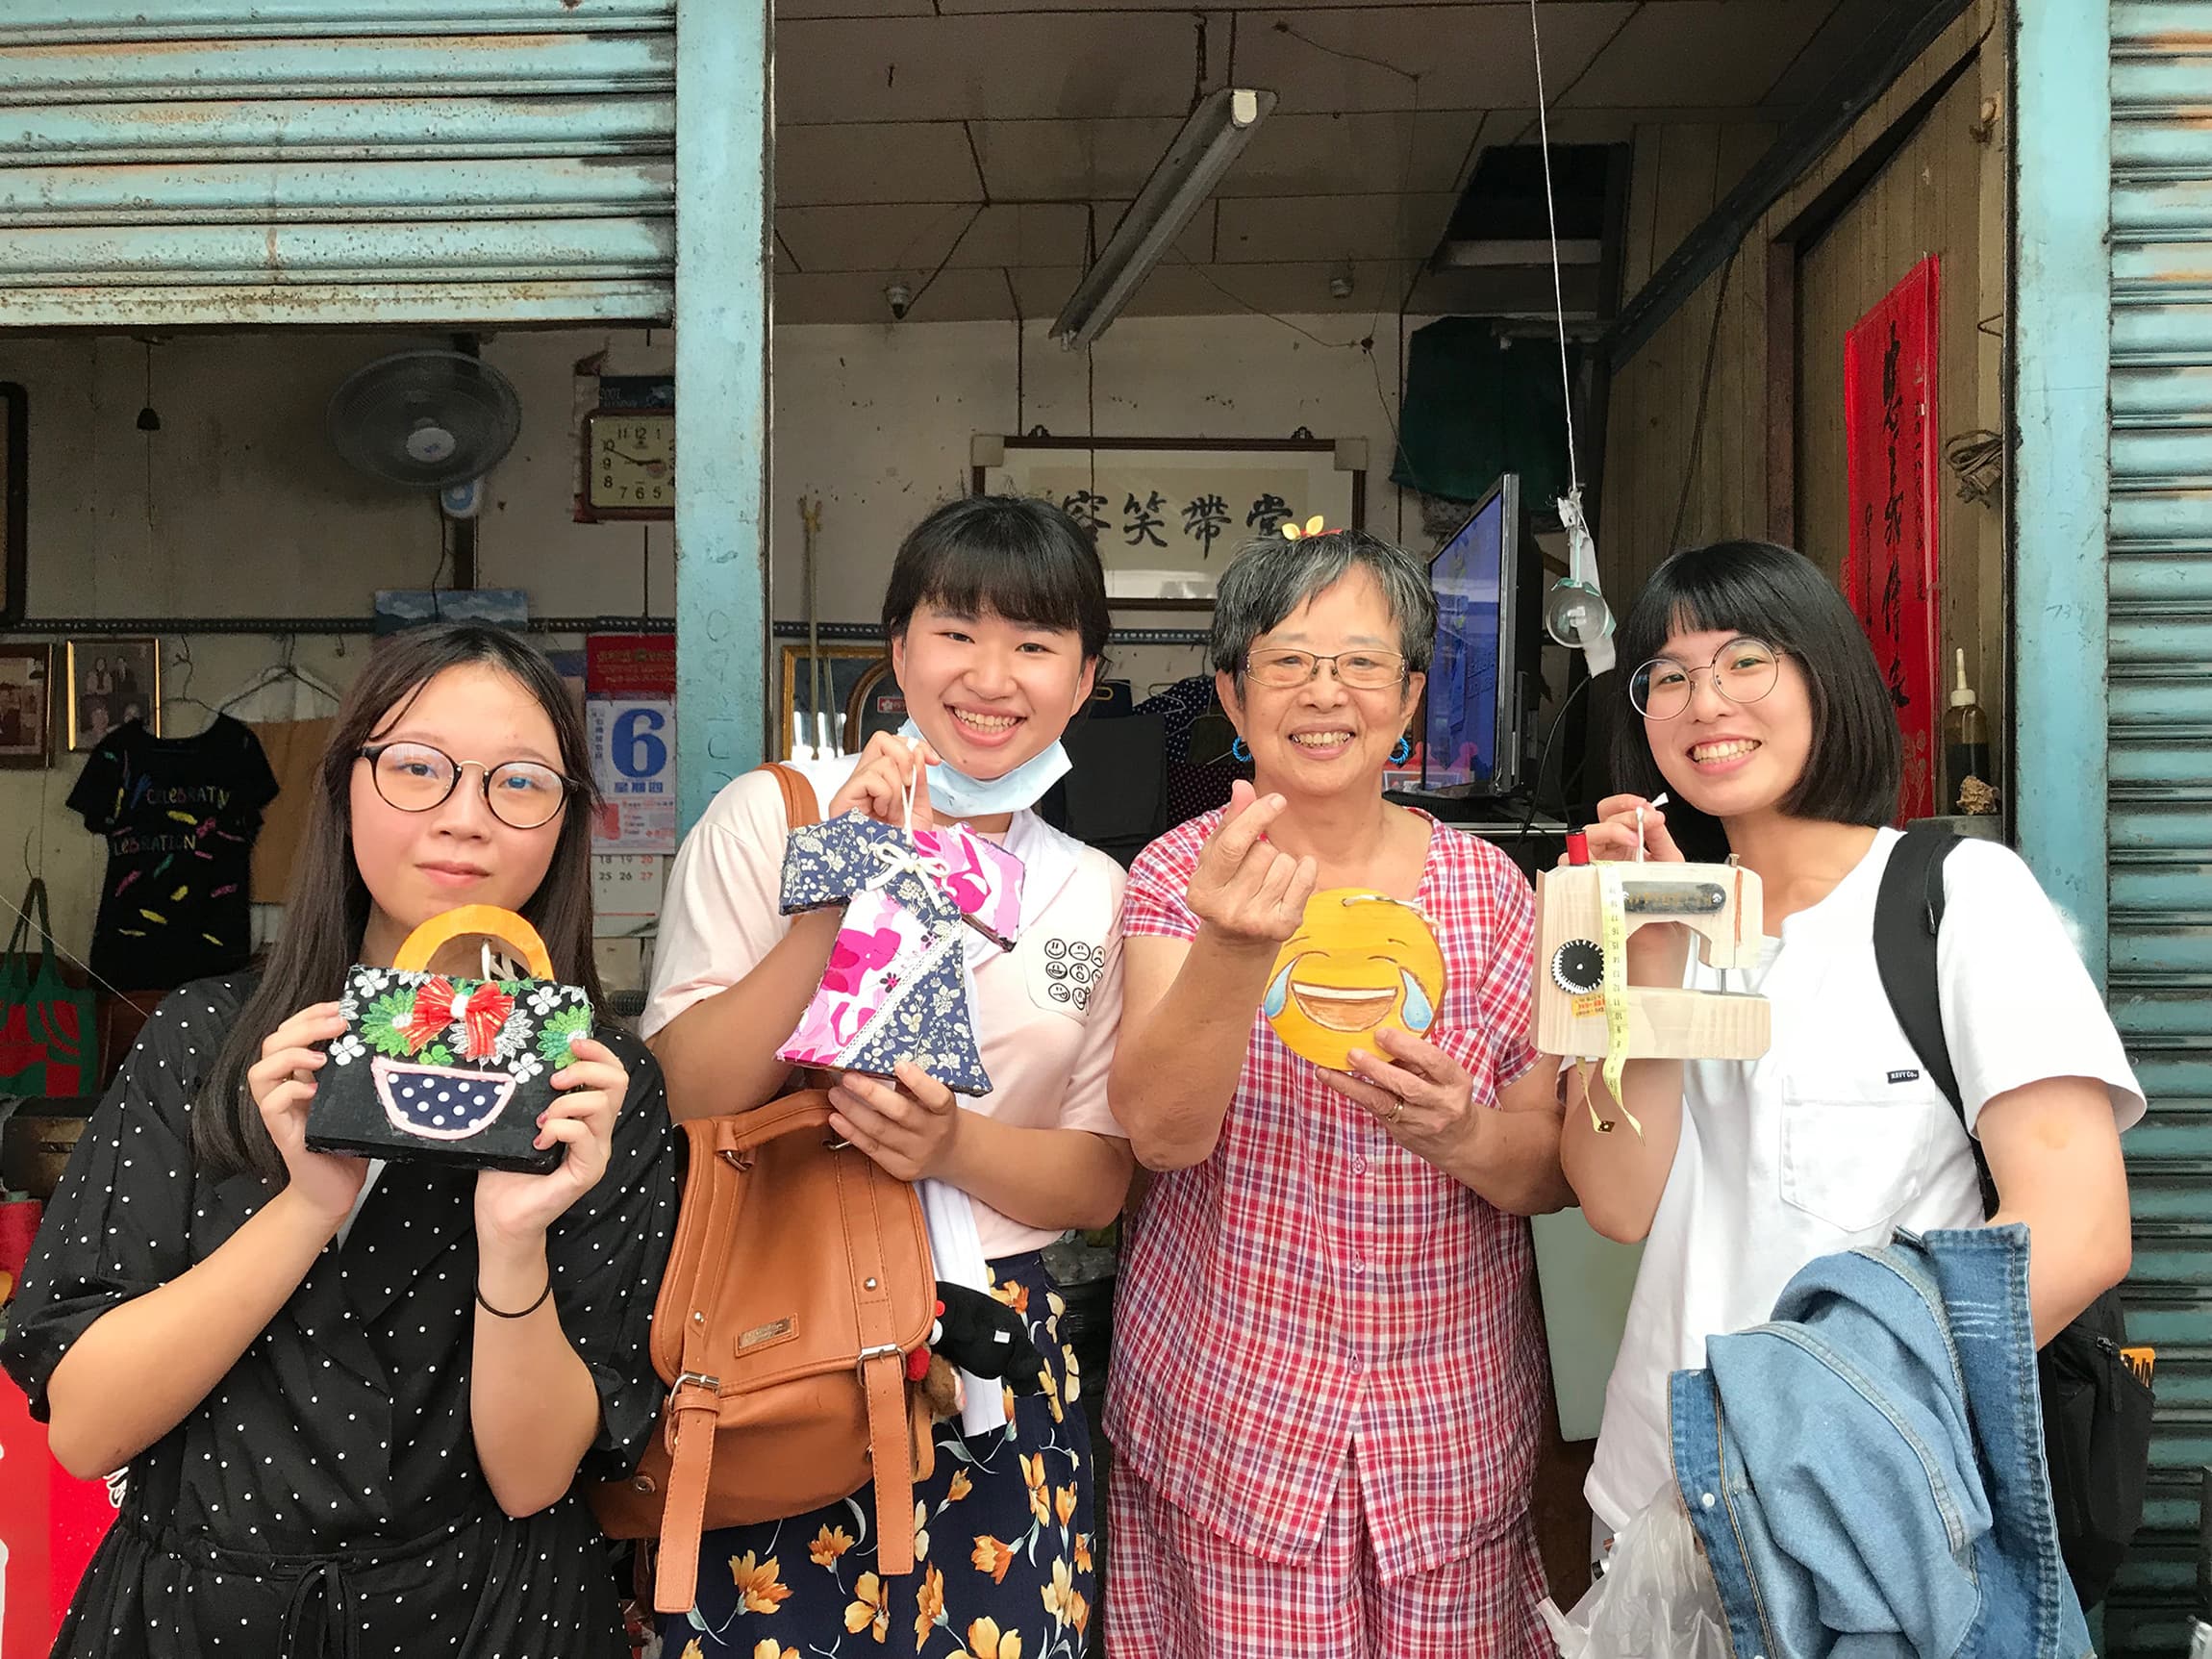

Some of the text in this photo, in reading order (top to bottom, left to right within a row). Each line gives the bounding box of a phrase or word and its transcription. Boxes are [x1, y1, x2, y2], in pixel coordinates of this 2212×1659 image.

[617, 428, 628, 440] 11
[635, 427, 647, 440] 12
[603, 457, 613, 470] 9
[603, 475, 614, 489] 8
[619, 487, 662, 500] 7 6 5
[611, 708, 667, 778] 6
[599, 871, 654, 882] 25 26 27
